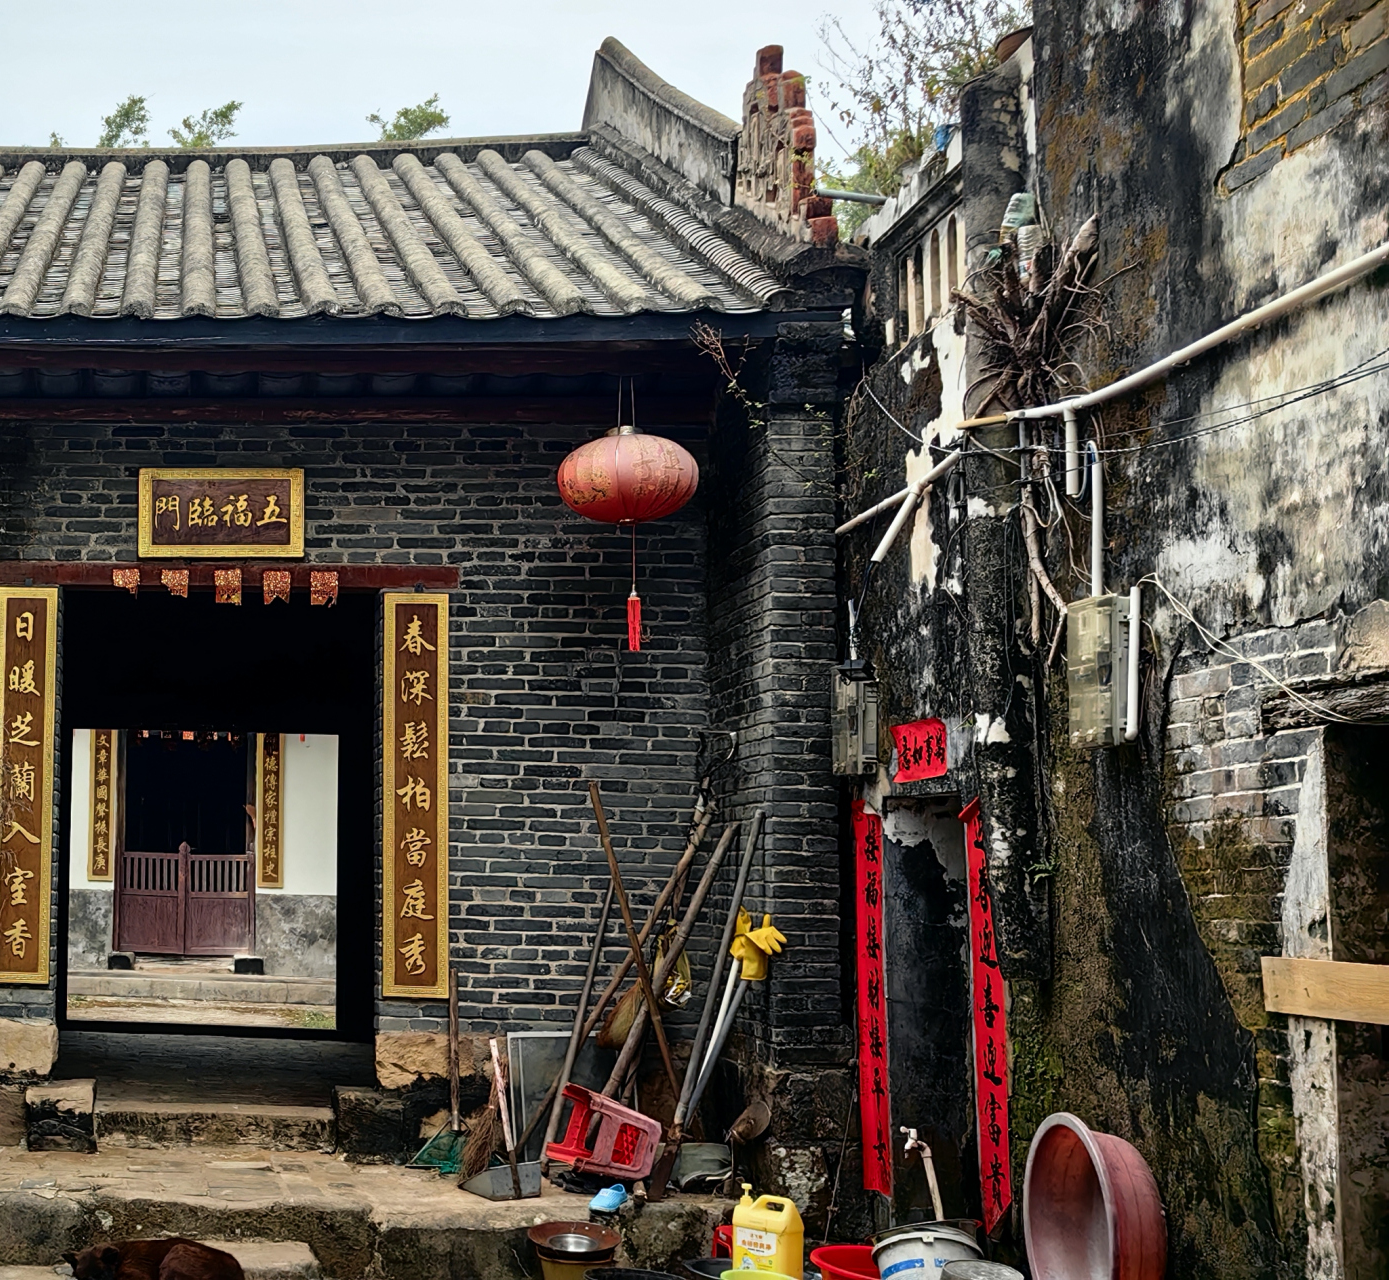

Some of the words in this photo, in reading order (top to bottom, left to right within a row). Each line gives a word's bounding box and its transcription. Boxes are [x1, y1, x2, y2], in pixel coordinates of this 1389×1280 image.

[155, 494, 288, 531] 五福臨門
[1, 611, 41, 960] 日暖芝蘭入室香
[263, 748, 279, 878] 德傳家禮宗柱史
[395, 615, 436, 975] 春深鬆柏當庭秀
